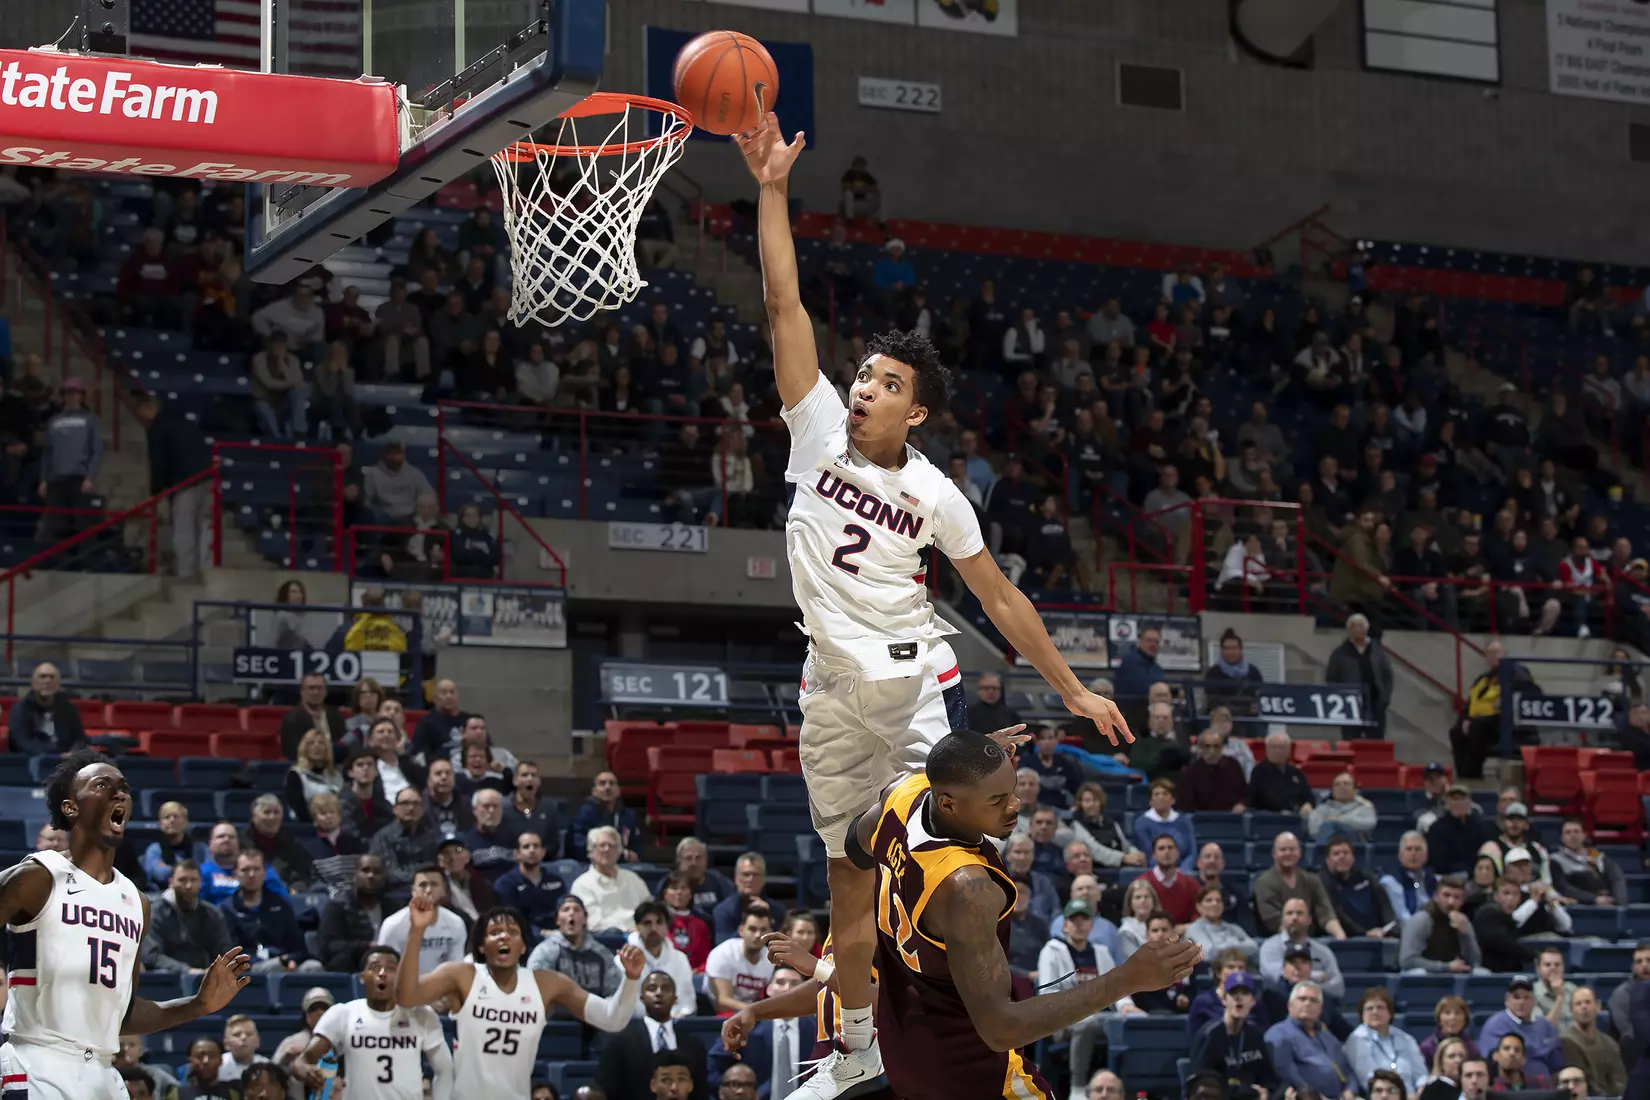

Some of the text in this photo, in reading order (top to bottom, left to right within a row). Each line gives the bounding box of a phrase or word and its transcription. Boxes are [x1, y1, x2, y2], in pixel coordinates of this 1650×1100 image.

[0, 61, 218, 124] tate Farm
[895, 85, 939, 108] 222
[0, 147, 352, 185] State Farm
[815, 469, 925, 540] UCONN
[612, 526, 706, 551] SEC 221
[831, 523, 872, 576] 2
[236, 651, 361, 682] SEC 120
[613, 671, 728, 702] SEC 121
[1260, 693, 1361, 720] SEC 121
[1521, 697, 1614, 725] SEC 122
[61, 902, 141, 944] UCONN
[87, 936, 121, 989] 15
[472, 1005, 537, 1024] UCONN
[351, 1035, 417, 1049] UCONN
[482, 1027, 521, 1056] 25
[376, 1055, 393, 1083] 3
